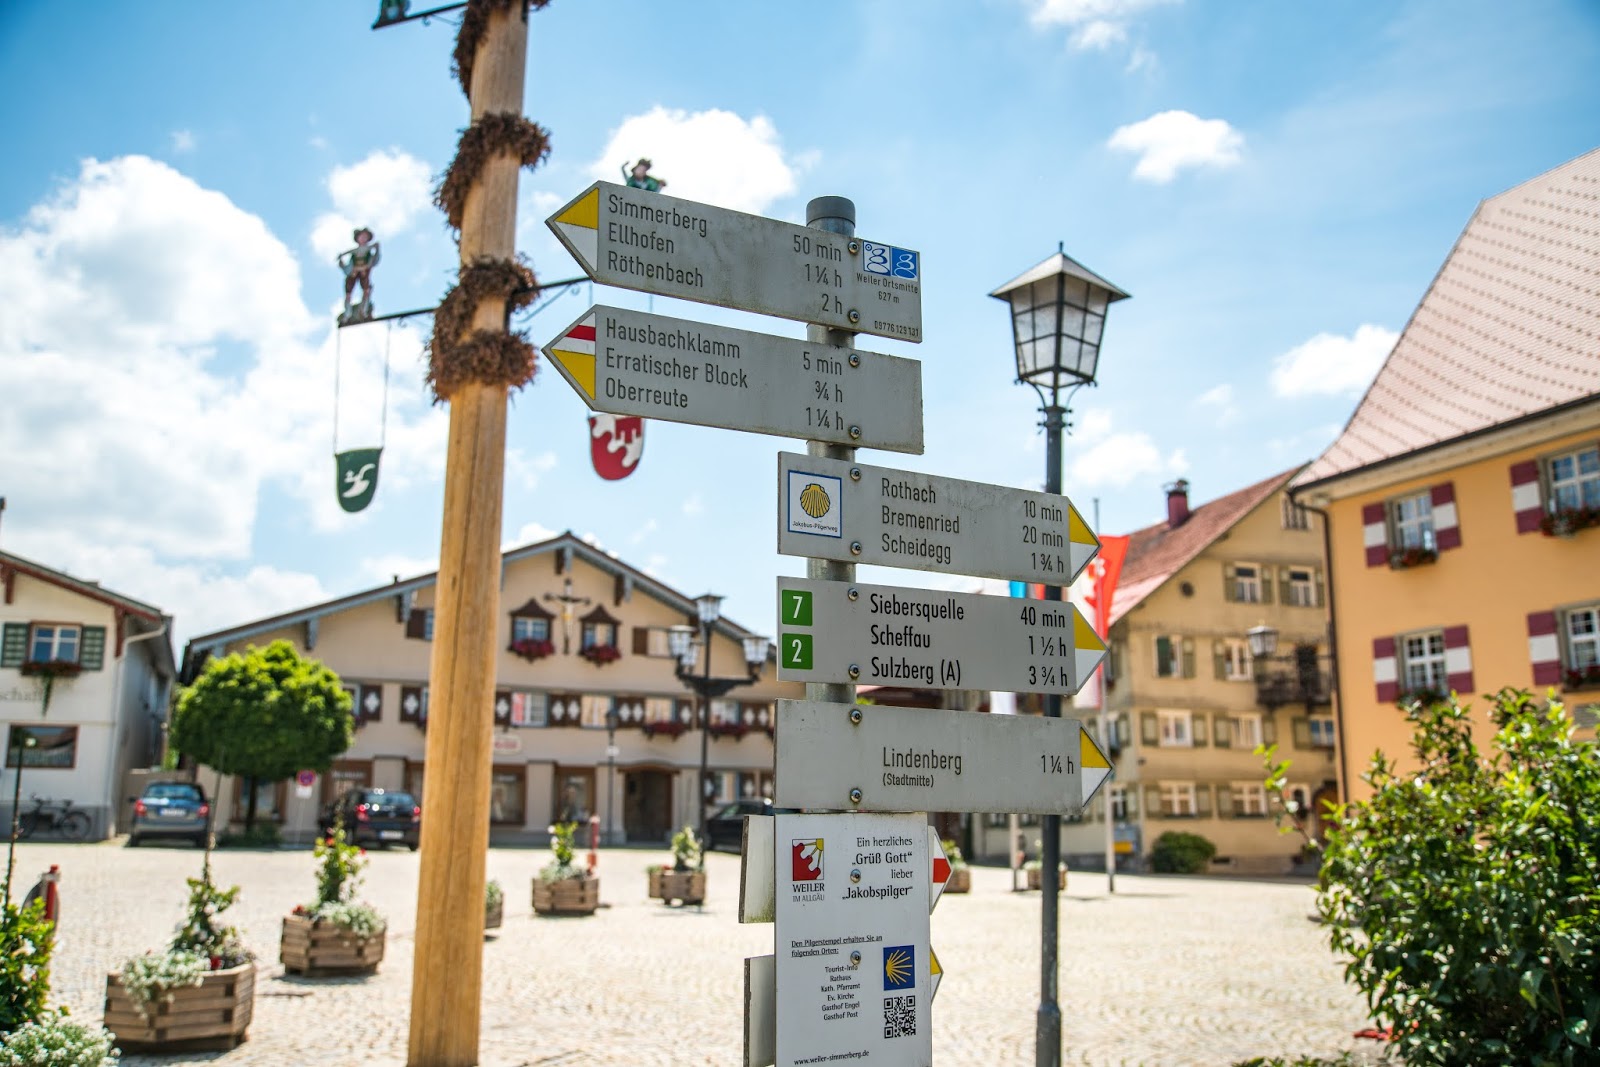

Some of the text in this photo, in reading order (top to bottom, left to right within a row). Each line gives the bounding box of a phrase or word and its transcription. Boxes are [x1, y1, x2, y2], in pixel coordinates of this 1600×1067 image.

[608, 193, 707, 238] Simmerberg
[608, 221, 674, 254] Ellhofen
[793, 234, 842, 262] 50 min
[608, 250, 703, 288] Röthenbach
[834, 269, 842, 288] h
[856, 272, 918, 294] Weiler Ortsmitte
[821, 293, 843, 315] 2 h
[878, 291, 900, 304] 627 m
[606, 317, 740, 359] Hausbachklamm
[606, 347, 748, 389] Erratischer Block
[803, 351, 842, 376] 5 min
[605, 377, 688, 408] Oberreute
[835, 383, 843, 403] h
[835, 411, 844, 431] h
[882, 477, 936, 504] Rothach
[882, 505, 960, 534] Bremenried
[1023, 499, 1063, 522] 10 min
[1023, 525, 1064, 548] 20 min
[882, 533, 951, 565] Scheidegg
[1057, 555, 1064, 573] h
[792, 595, 803, 619] 7
[870, 593, 965, 622] Siebersquelle
[1020, 606, 1066, 628] 40 min
[870, 624, 931, 648] Scheffau
[1059, 636, 1067, 657] h
[791, 639, 802, 663] 2
[871, 656, 961, 686] Sulzberg (A)
[1028, 665, 1037, 685] 3
[1060, 666, 1068, 687] h
[883, 746, 962, 776] Lindenberg
[1067, 755, 1074, 774] h
[882, 772, 934, 788] (Stadtmitte)
[856, 836, 912, 847] Ein herzliches
[852, 852, 912, 866] „Grüß Gott“
[891, 869, 913, 879] lieber
[792, 883, 825, 893] WEILER
[802, 893, 825, 902] ALLGÄU
[842, 885, 913, 900] „Jakobspilger“
[804, 937, 842, 947] Pilgerstempel
[843, 936, 865, 944] erhalten
[866, 934, 875, 942] Sie
[791, 947, 839, 957] folgenden Orten:
[825, 965, 858, 973] Tourist-Info
[830, 974, 852, 982] Rathaus
[836, 983, 861, 991] Pfarramt
[837, 993, 855, 1001] Kirche
[821, 1001, 860, 1011] Gasthof Engel
[823, 1012, 846, 1021] Gasthof
[794, 1050, 869, 1065] www.weiler-simmerberg.de
